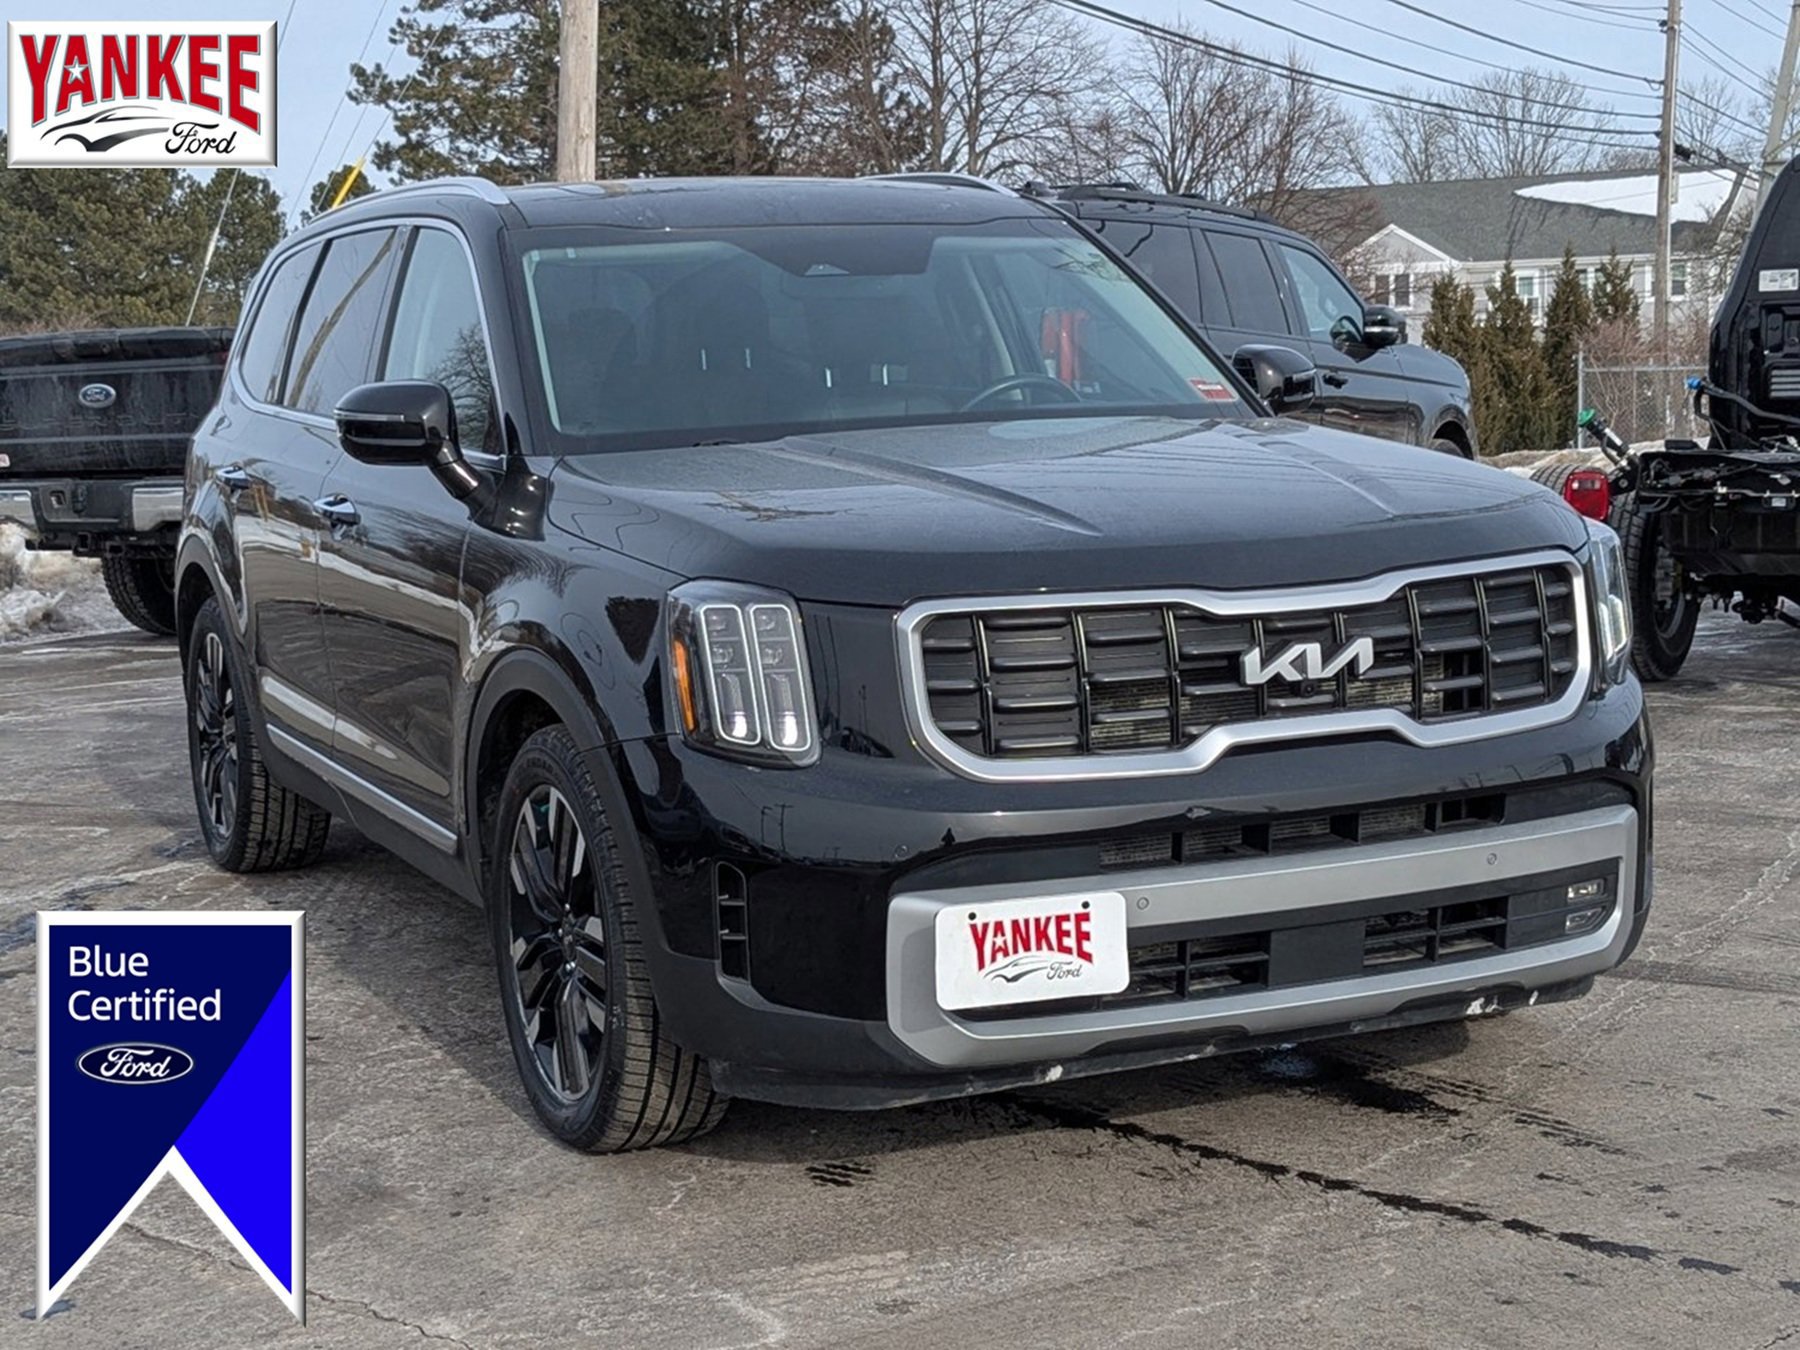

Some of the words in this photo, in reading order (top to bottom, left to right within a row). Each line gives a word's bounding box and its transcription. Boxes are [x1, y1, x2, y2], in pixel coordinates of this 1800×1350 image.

[1244, 637, 1374, 685] KIA
[969, 911, 1094, 972] YANKEE
[1046, 961, 1083, 980] Ford
